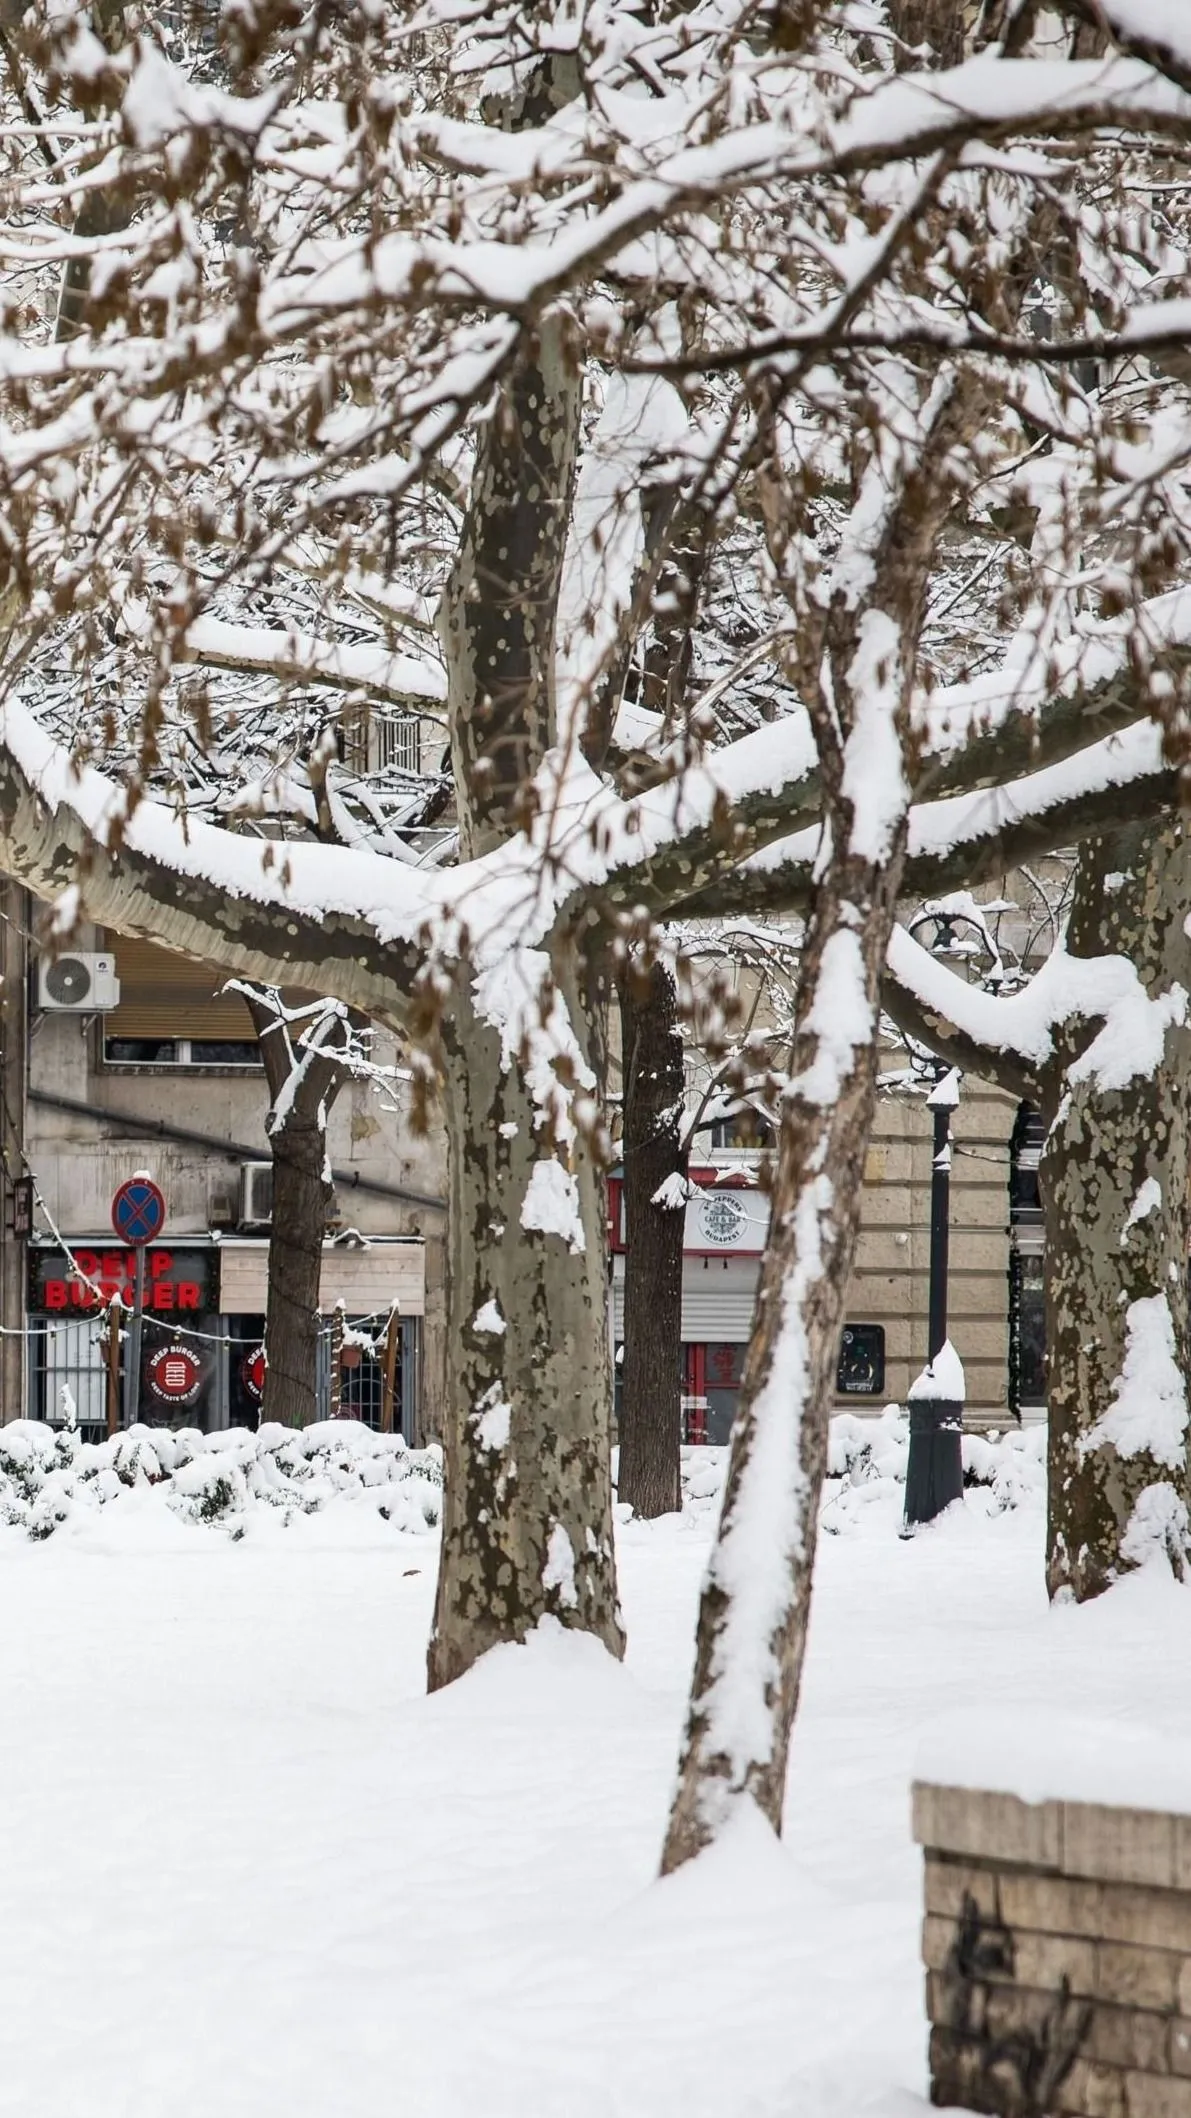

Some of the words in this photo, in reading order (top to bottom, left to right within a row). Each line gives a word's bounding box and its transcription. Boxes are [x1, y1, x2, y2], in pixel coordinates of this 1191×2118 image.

[705, 1229, 740, 1242] BUDAPEST
[150, 1347, 169, 1367] DEEP
[170, 1345, 201, 1367] BURGER
[162, 1393, 180, 1402] TASTE
